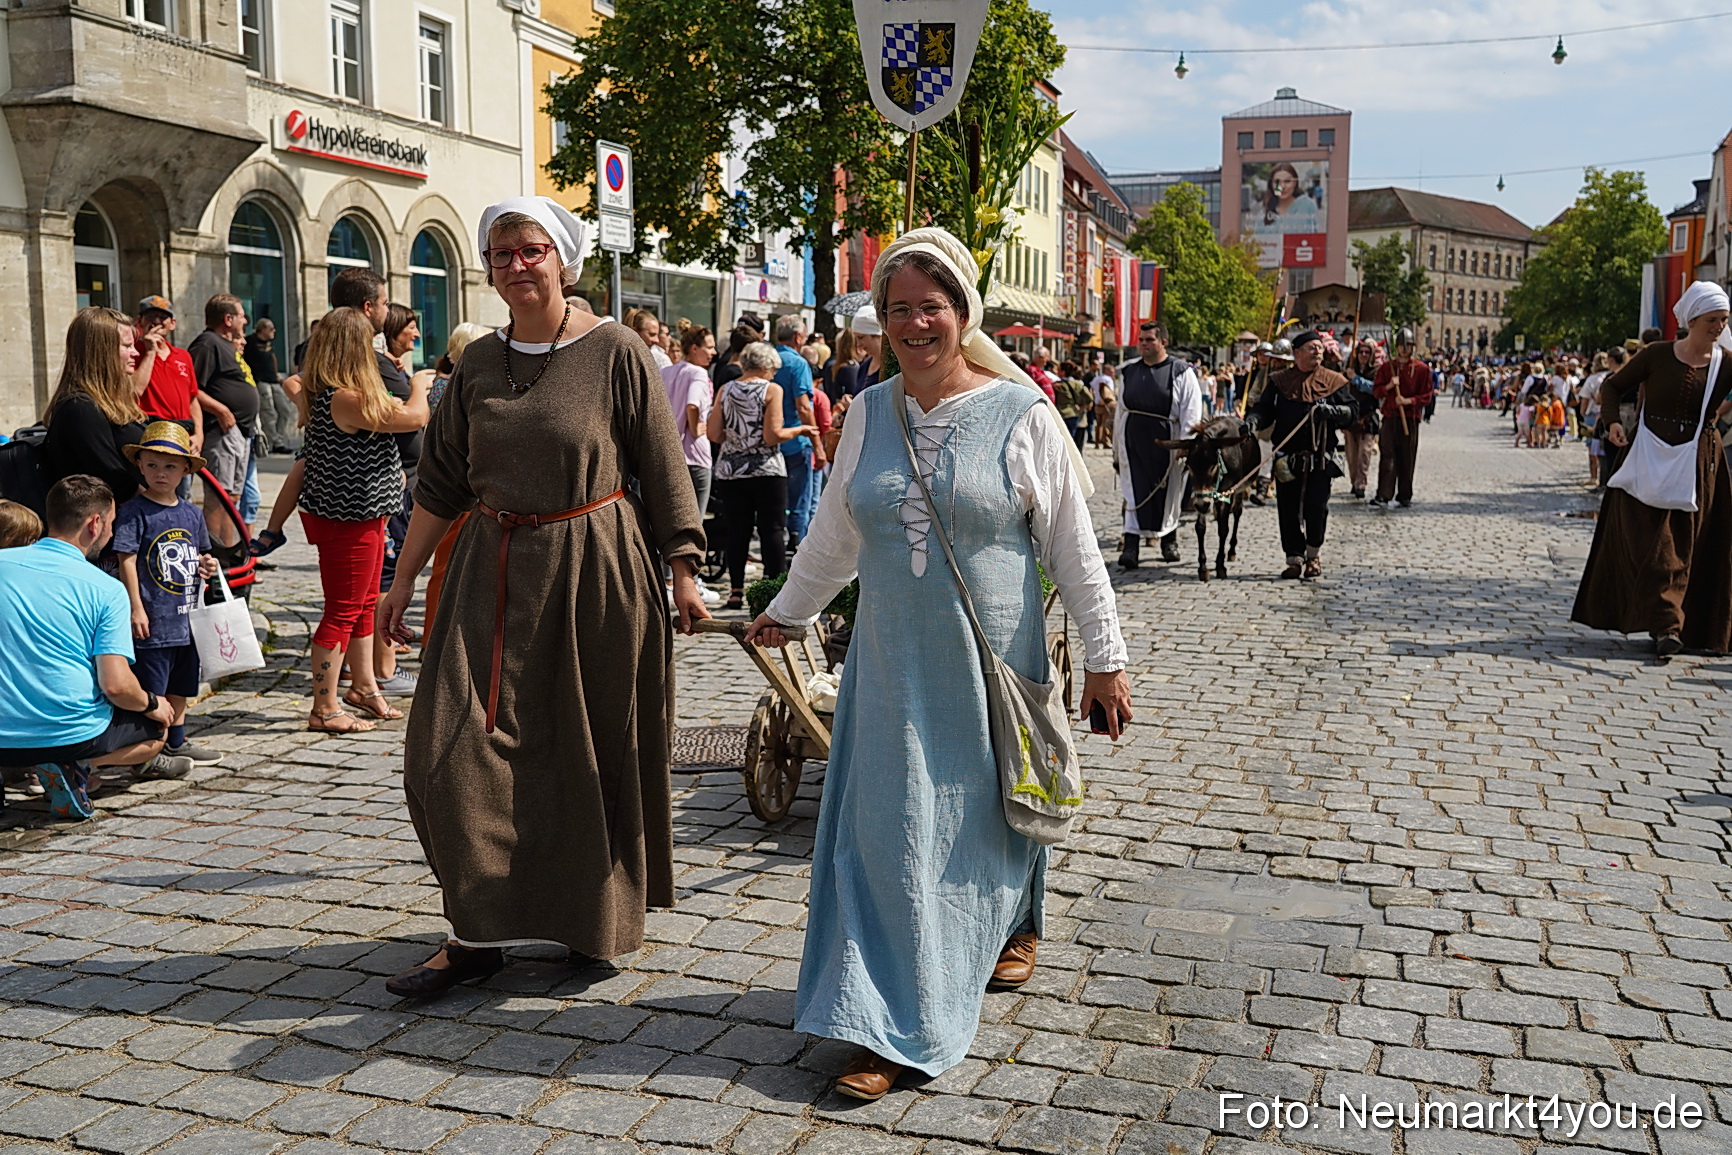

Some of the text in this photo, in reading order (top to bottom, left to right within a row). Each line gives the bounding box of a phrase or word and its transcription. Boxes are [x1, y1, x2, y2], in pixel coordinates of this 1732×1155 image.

[309, 116, 428, 166] HypoVereinsbank
[608, 193, 624, 205] ZONE
[167, 531, 183, 539] PARK
